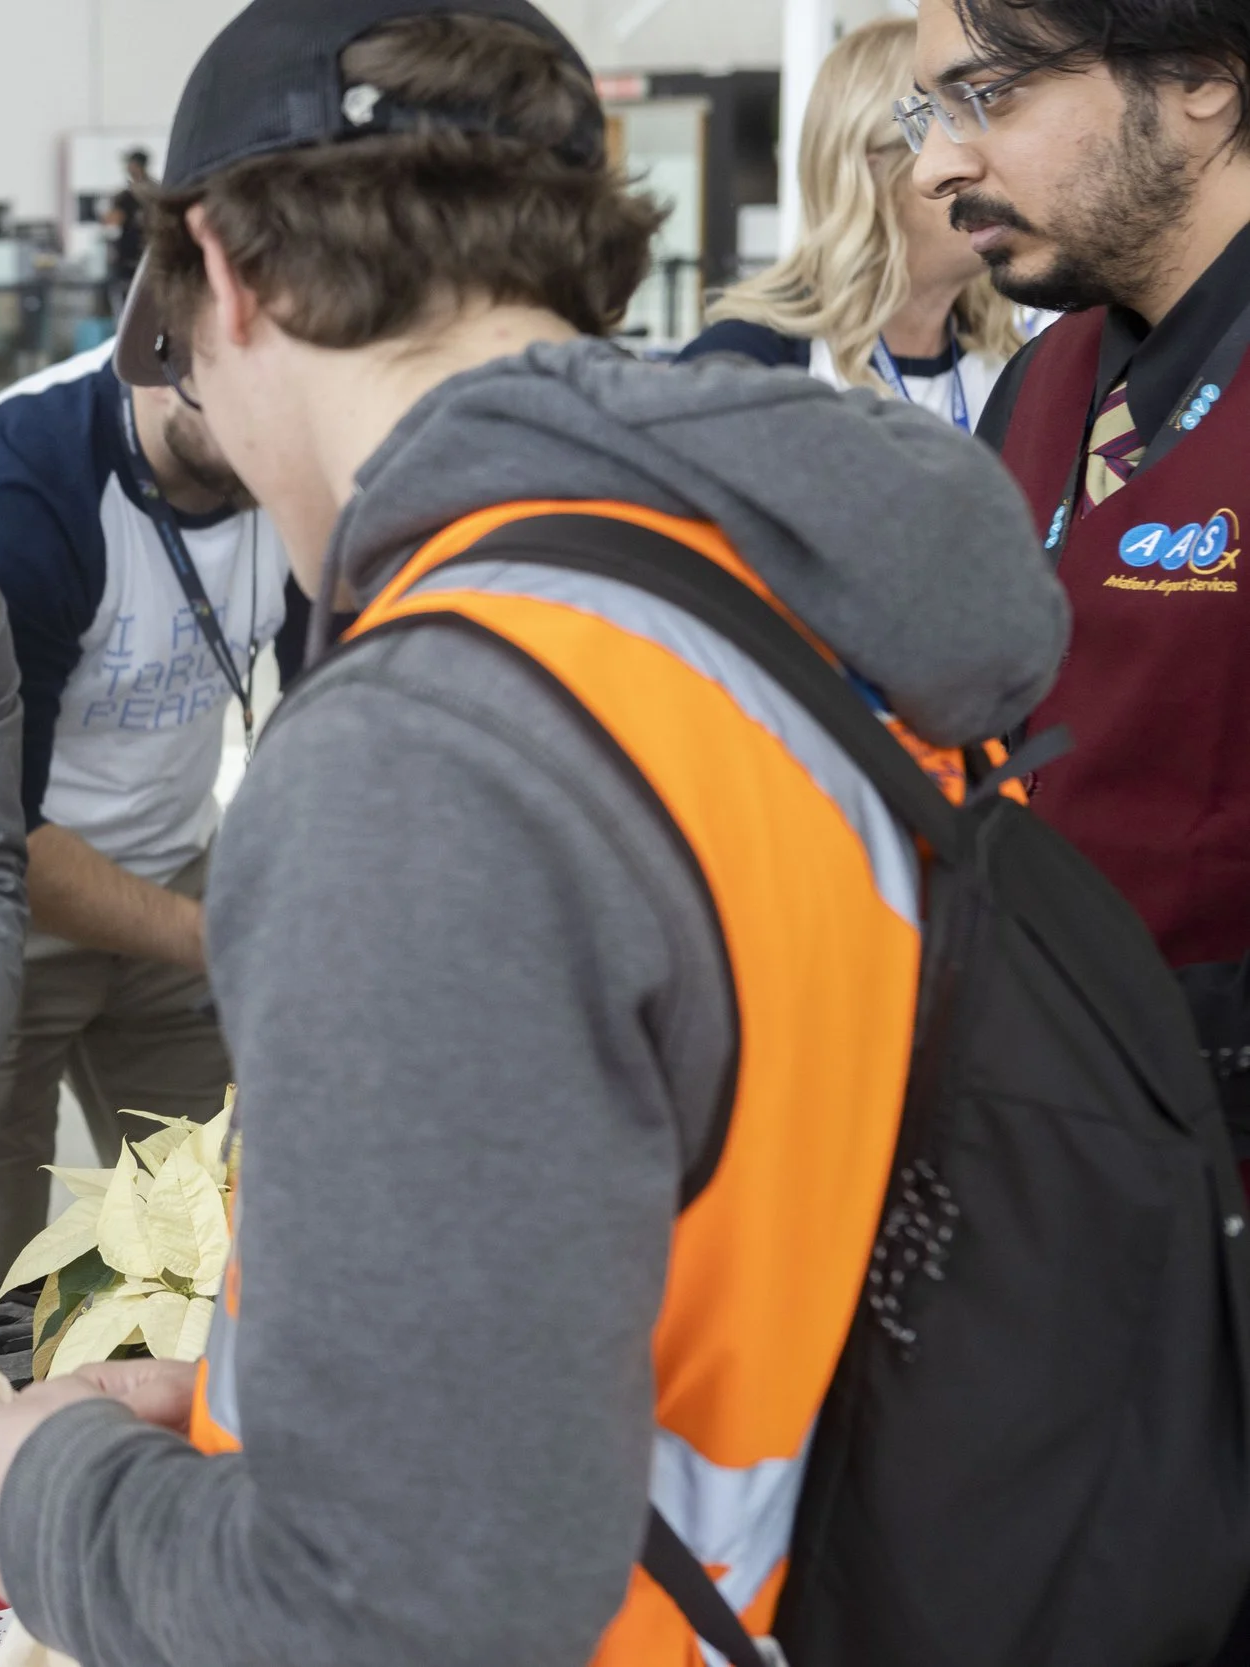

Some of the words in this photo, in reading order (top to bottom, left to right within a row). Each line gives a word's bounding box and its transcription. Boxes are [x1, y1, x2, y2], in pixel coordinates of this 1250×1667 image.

[1184, 386, 1216, 427] AAS
[1123, 524, 1222, 560] AAS
[1103, 574, 1147, 591] Aviation
[1153, 579, 1190, 597] Airport
[1188, 577, 1238, 592] Services
[106, 614, 135, 658] I
[82, 683, 229, 731] PEAR
